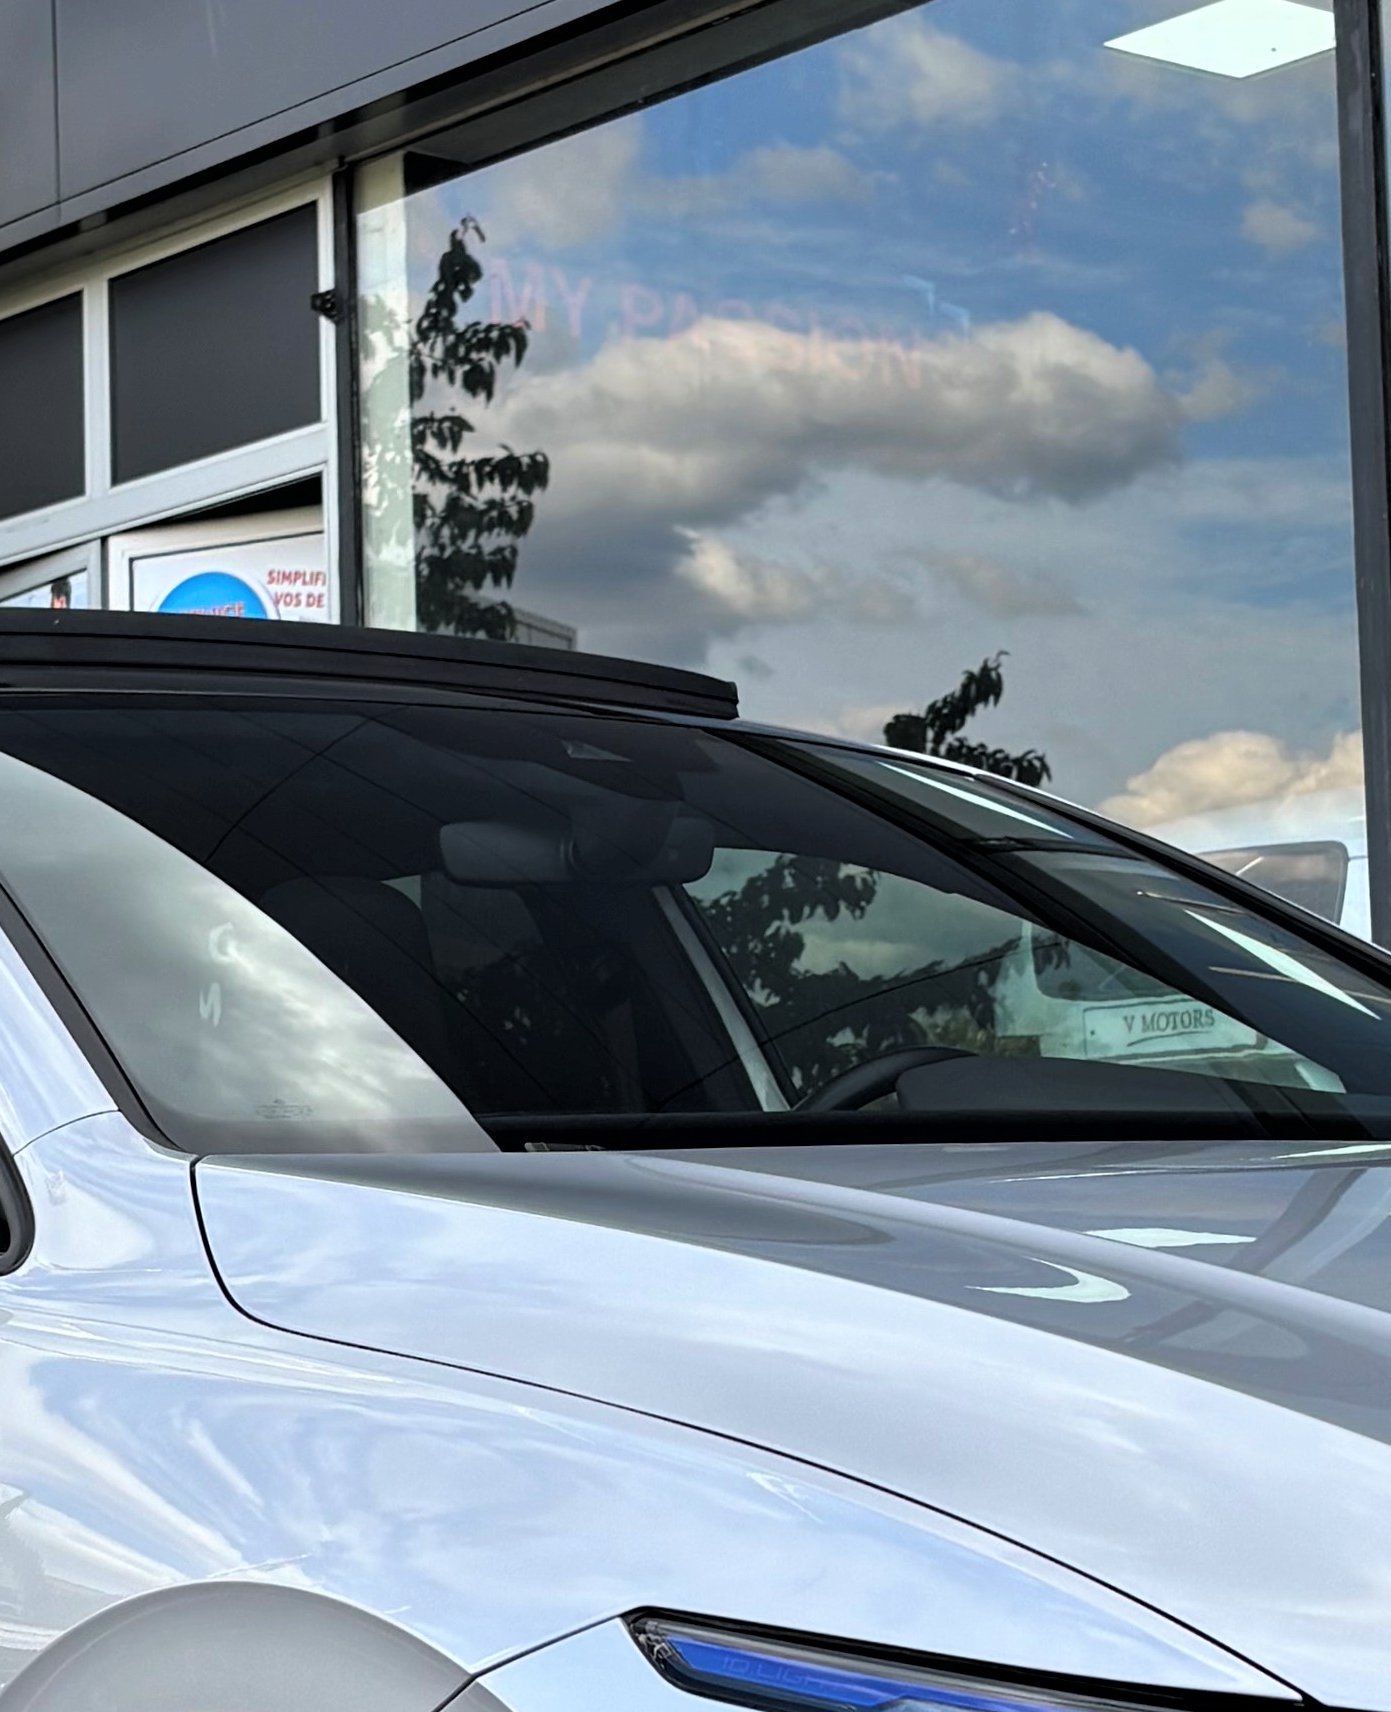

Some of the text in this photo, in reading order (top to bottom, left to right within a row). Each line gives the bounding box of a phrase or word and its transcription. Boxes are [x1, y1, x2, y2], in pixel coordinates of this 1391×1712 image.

[488, 257, 594, 339] MY
[273, 591, 301, 608] VOS
[1122, 1007, 1216, 1034] V MOTORS
